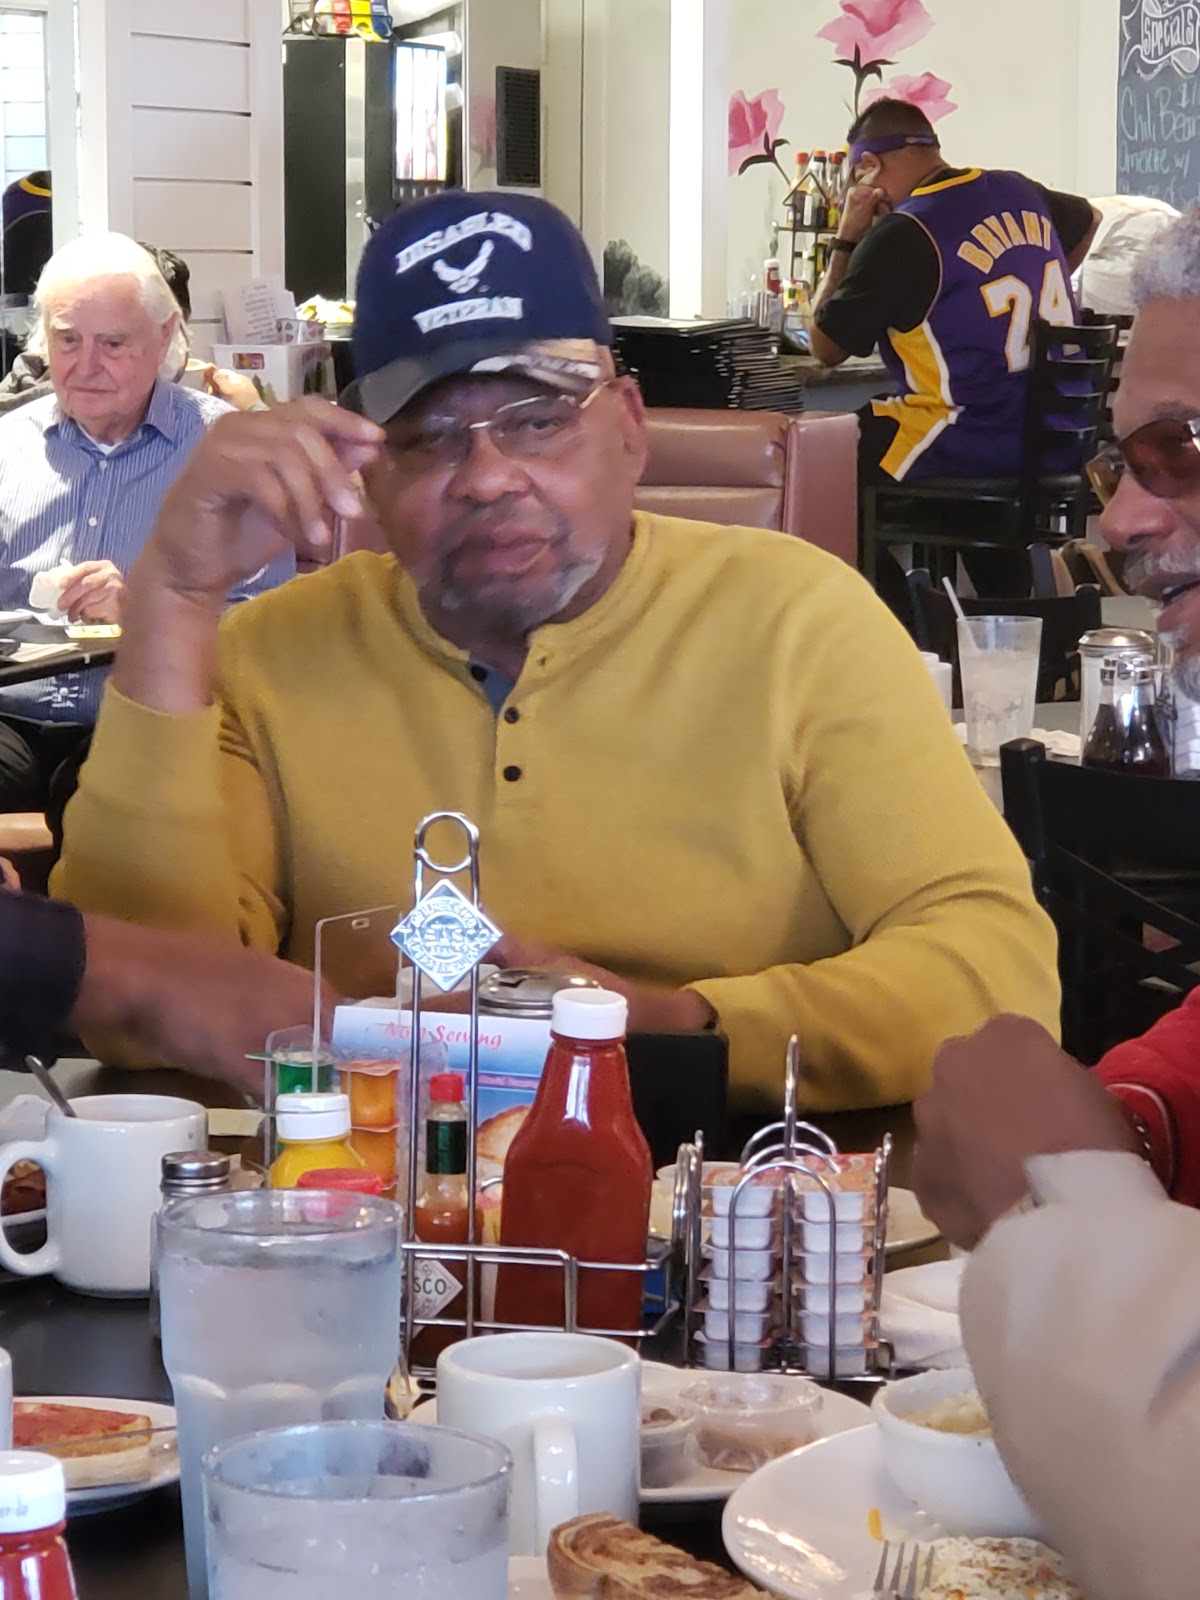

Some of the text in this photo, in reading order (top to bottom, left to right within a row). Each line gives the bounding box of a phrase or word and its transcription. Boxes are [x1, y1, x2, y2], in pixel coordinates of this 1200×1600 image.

[1120, 86, 1156, 143] Chili
[956, 210, 1052, 275] BRYANT
[979, 259, 1076, 374] 24
[435, 1024, 502, 1052] Servng
